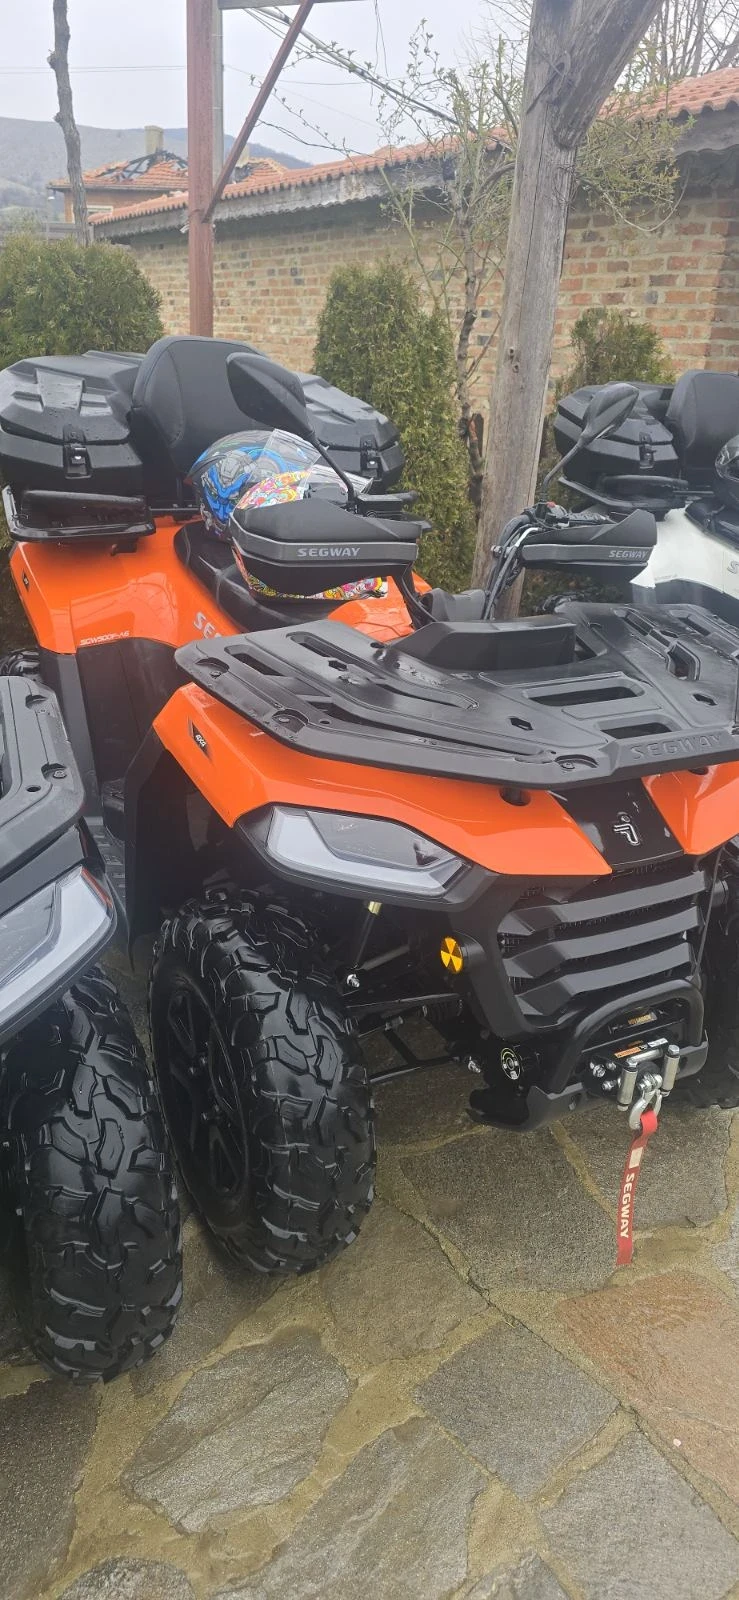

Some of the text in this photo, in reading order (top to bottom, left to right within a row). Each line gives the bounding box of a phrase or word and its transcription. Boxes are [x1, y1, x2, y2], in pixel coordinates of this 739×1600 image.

[297, 547, 361, 558] SEGWAY
[608, 549, 649, 559] SEGWAY
[630, 734, 722, 761] SEGWAY
[620, 1172, 635, 1239] SEGWAY
